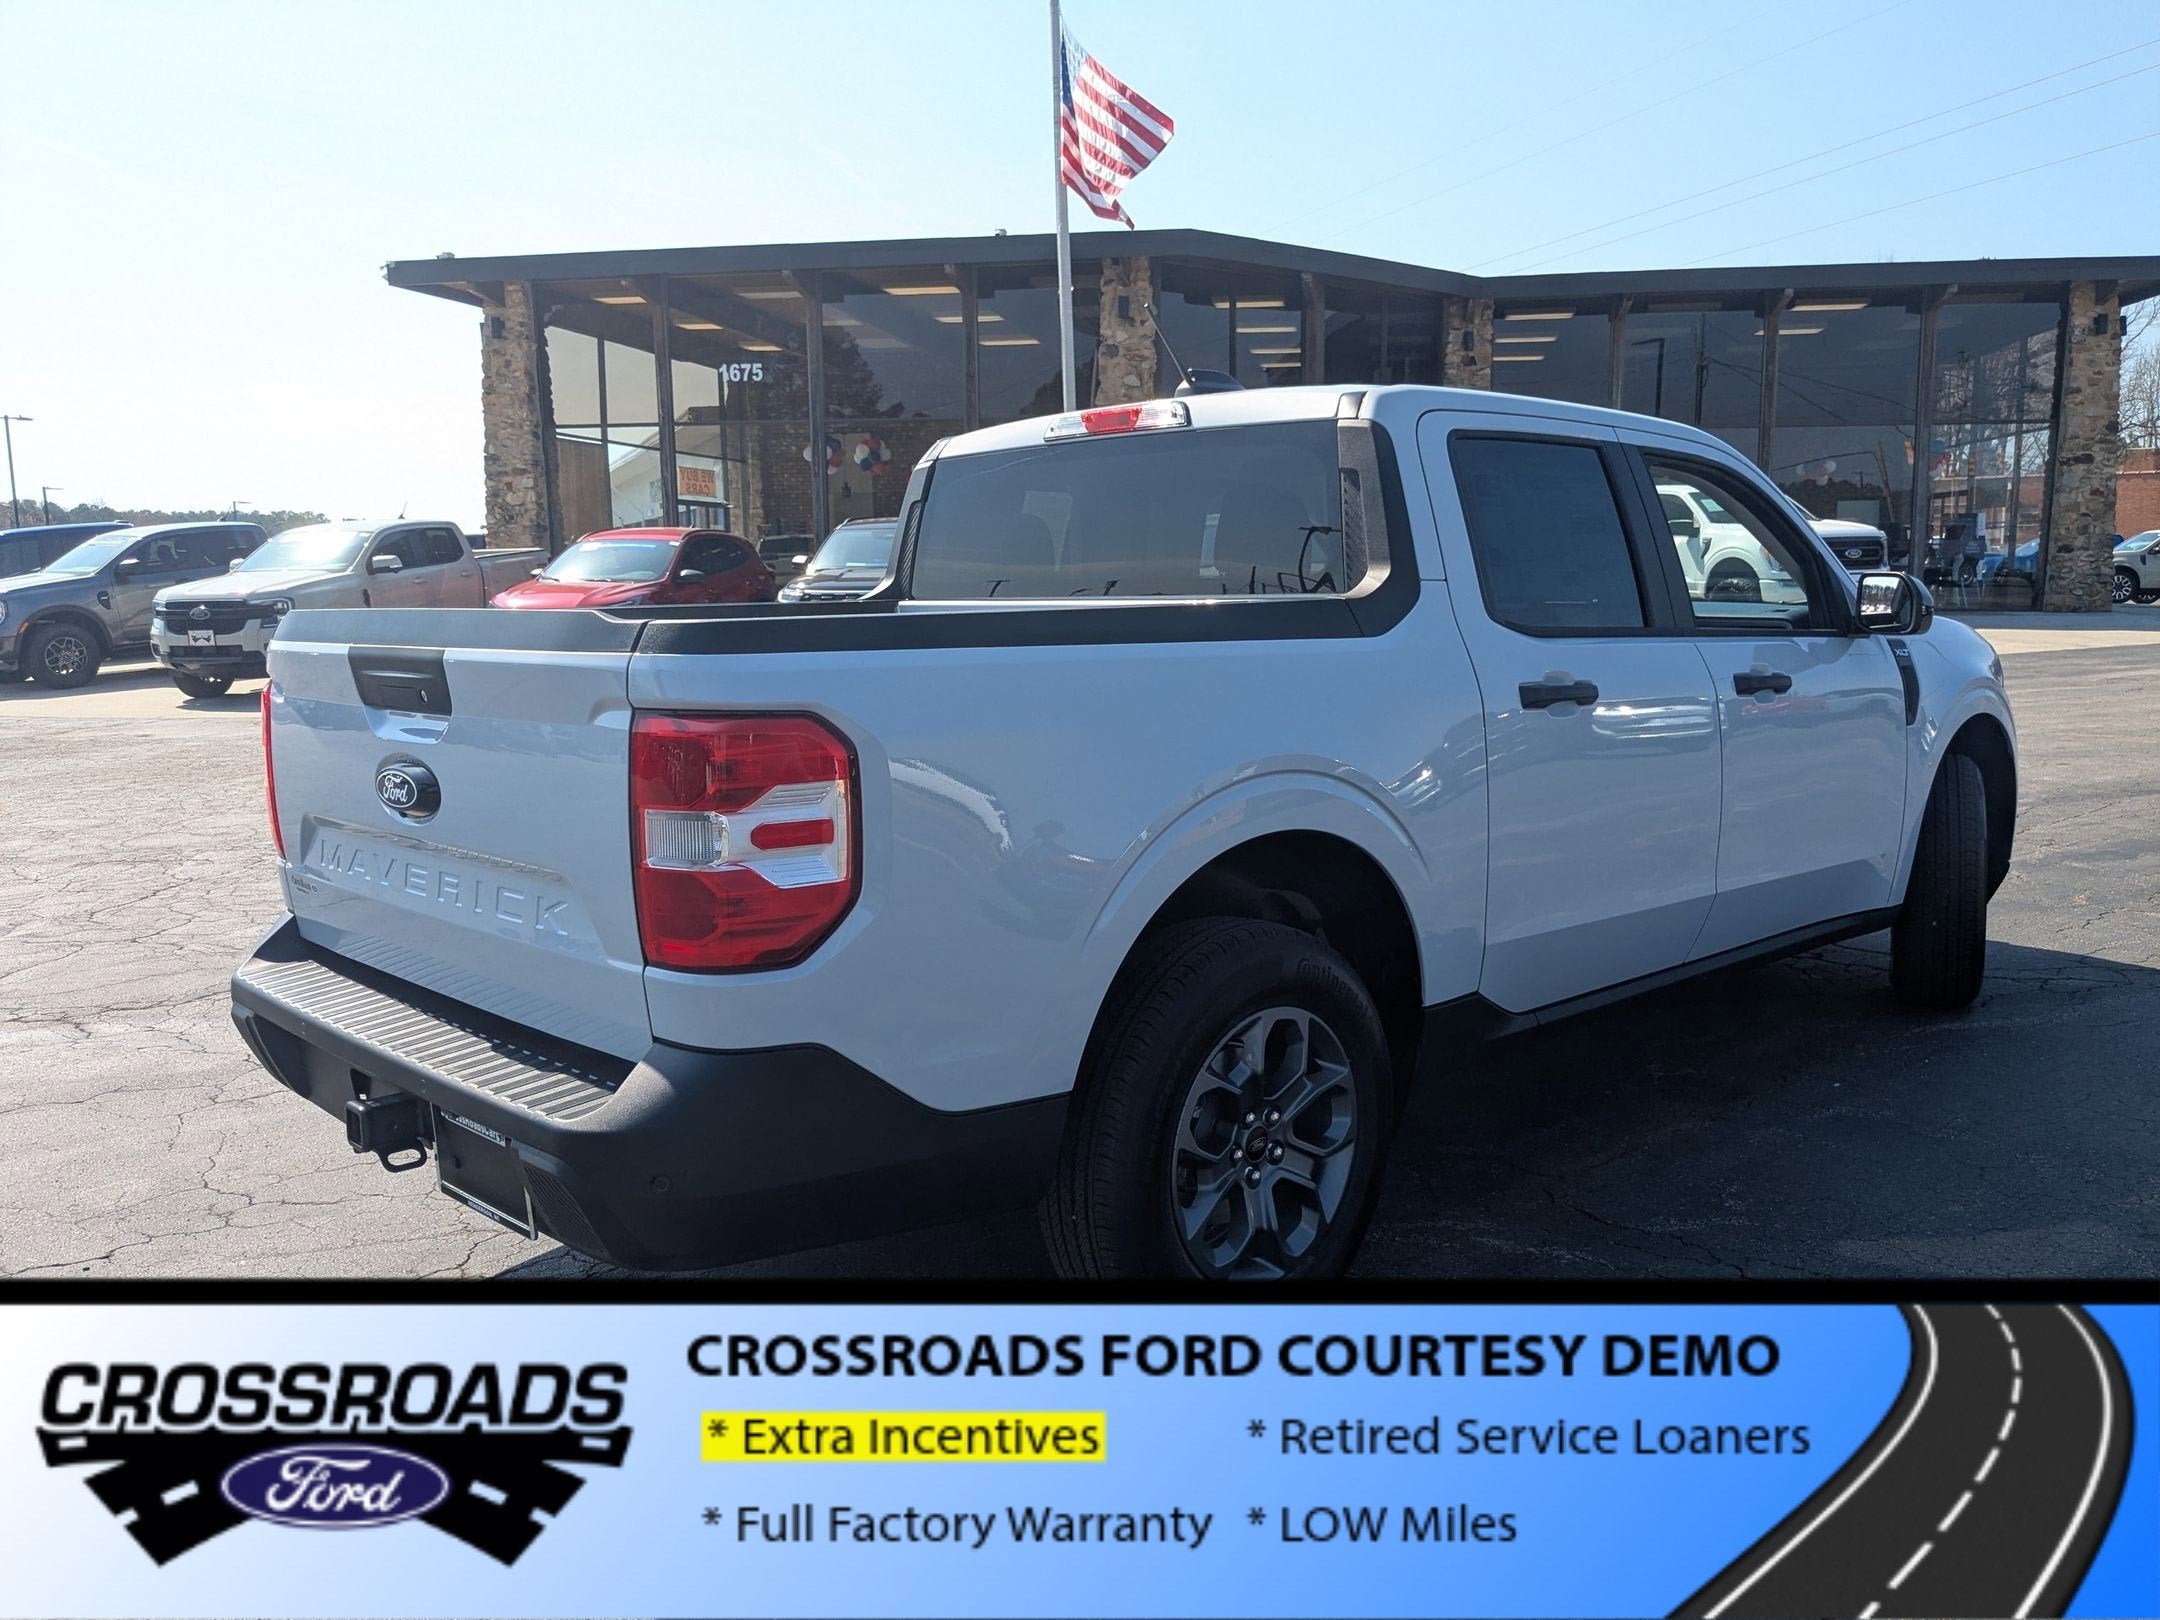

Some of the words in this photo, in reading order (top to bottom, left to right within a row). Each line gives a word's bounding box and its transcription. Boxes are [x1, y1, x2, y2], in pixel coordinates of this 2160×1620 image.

[719, 363, 763, 382] 1675
[1894, 648, 1910, 656] XLT
[383, 774, 409, 802] Ford
[319, 838, 569, 937] MAVERICK
